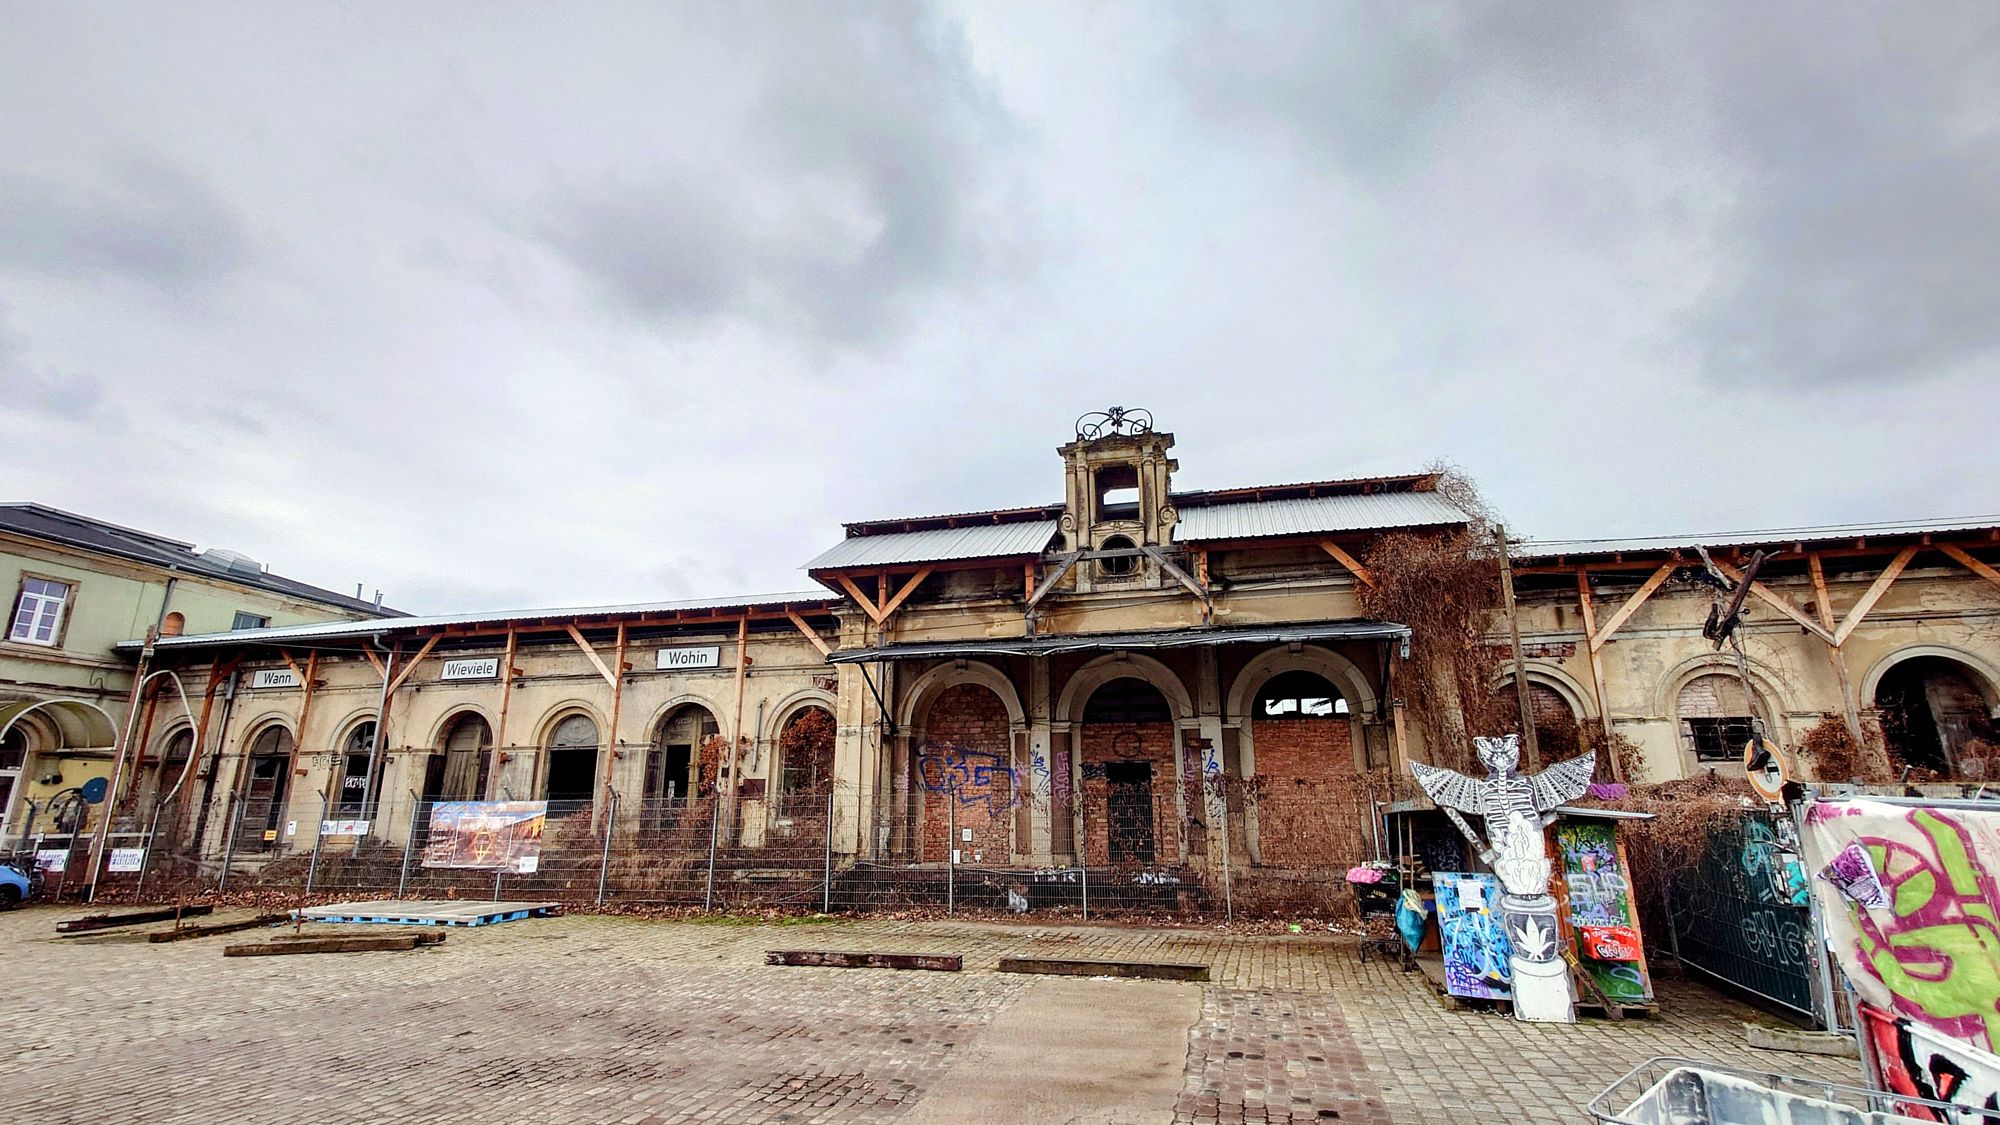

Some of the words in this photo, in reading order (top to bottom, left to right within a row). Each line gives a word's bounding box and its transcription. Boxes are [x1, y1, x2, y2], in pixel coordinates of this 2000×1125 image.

[669, 650, 708, 665] Wohin
[447, 662, 493, 676] Wieviele
[264, 672, 292, 685] Wann
